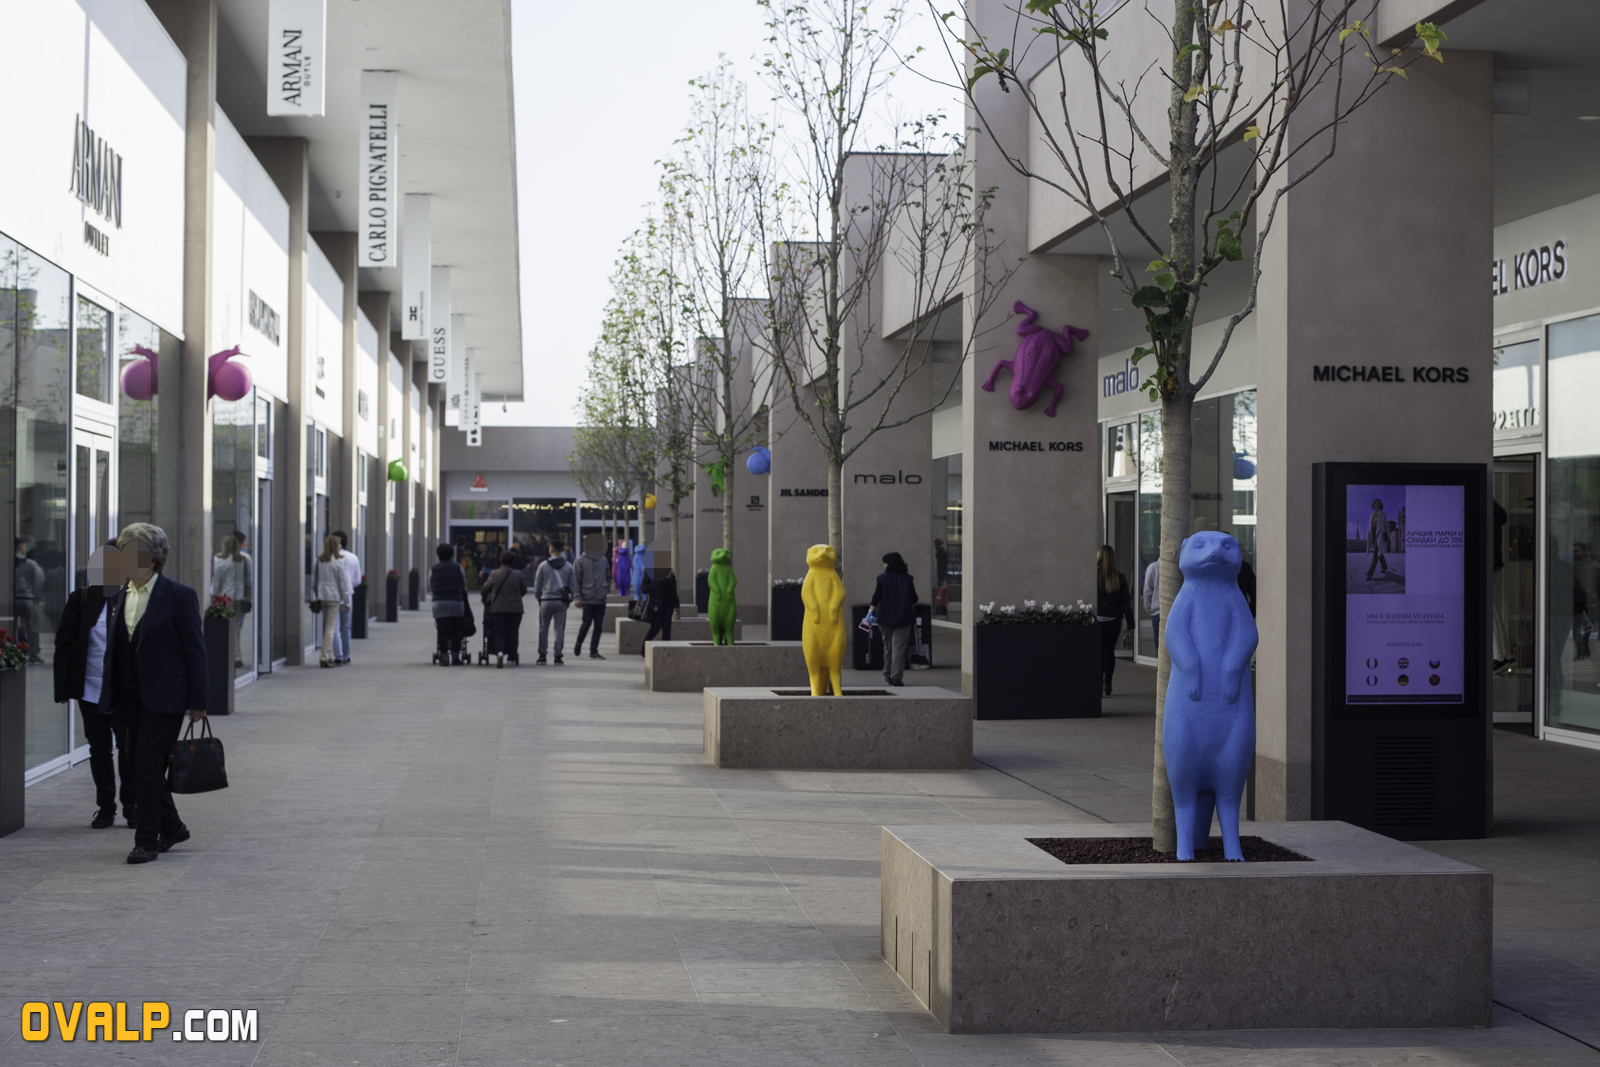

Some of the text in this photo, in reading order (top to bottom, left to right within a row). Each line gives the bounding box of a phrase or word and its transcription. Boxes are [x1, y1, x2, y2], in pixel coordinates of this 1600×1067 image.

[282, 29, 302, 107] ARMANI
[368, 104, 388, 262] CARLO PIGNATELLI
[1514, 239, 1567, 291] KORS
[433, 327, 446, 379] GUESS
[1103, 358, 1140, 397] malo
[1313, 365, 1469, 383] MICHAEL KORS
[989, 441, 1084, 452] MICHAEL KORS
[780, 489, 793, 497] JIL
[854, 470, 922, 485] malo
